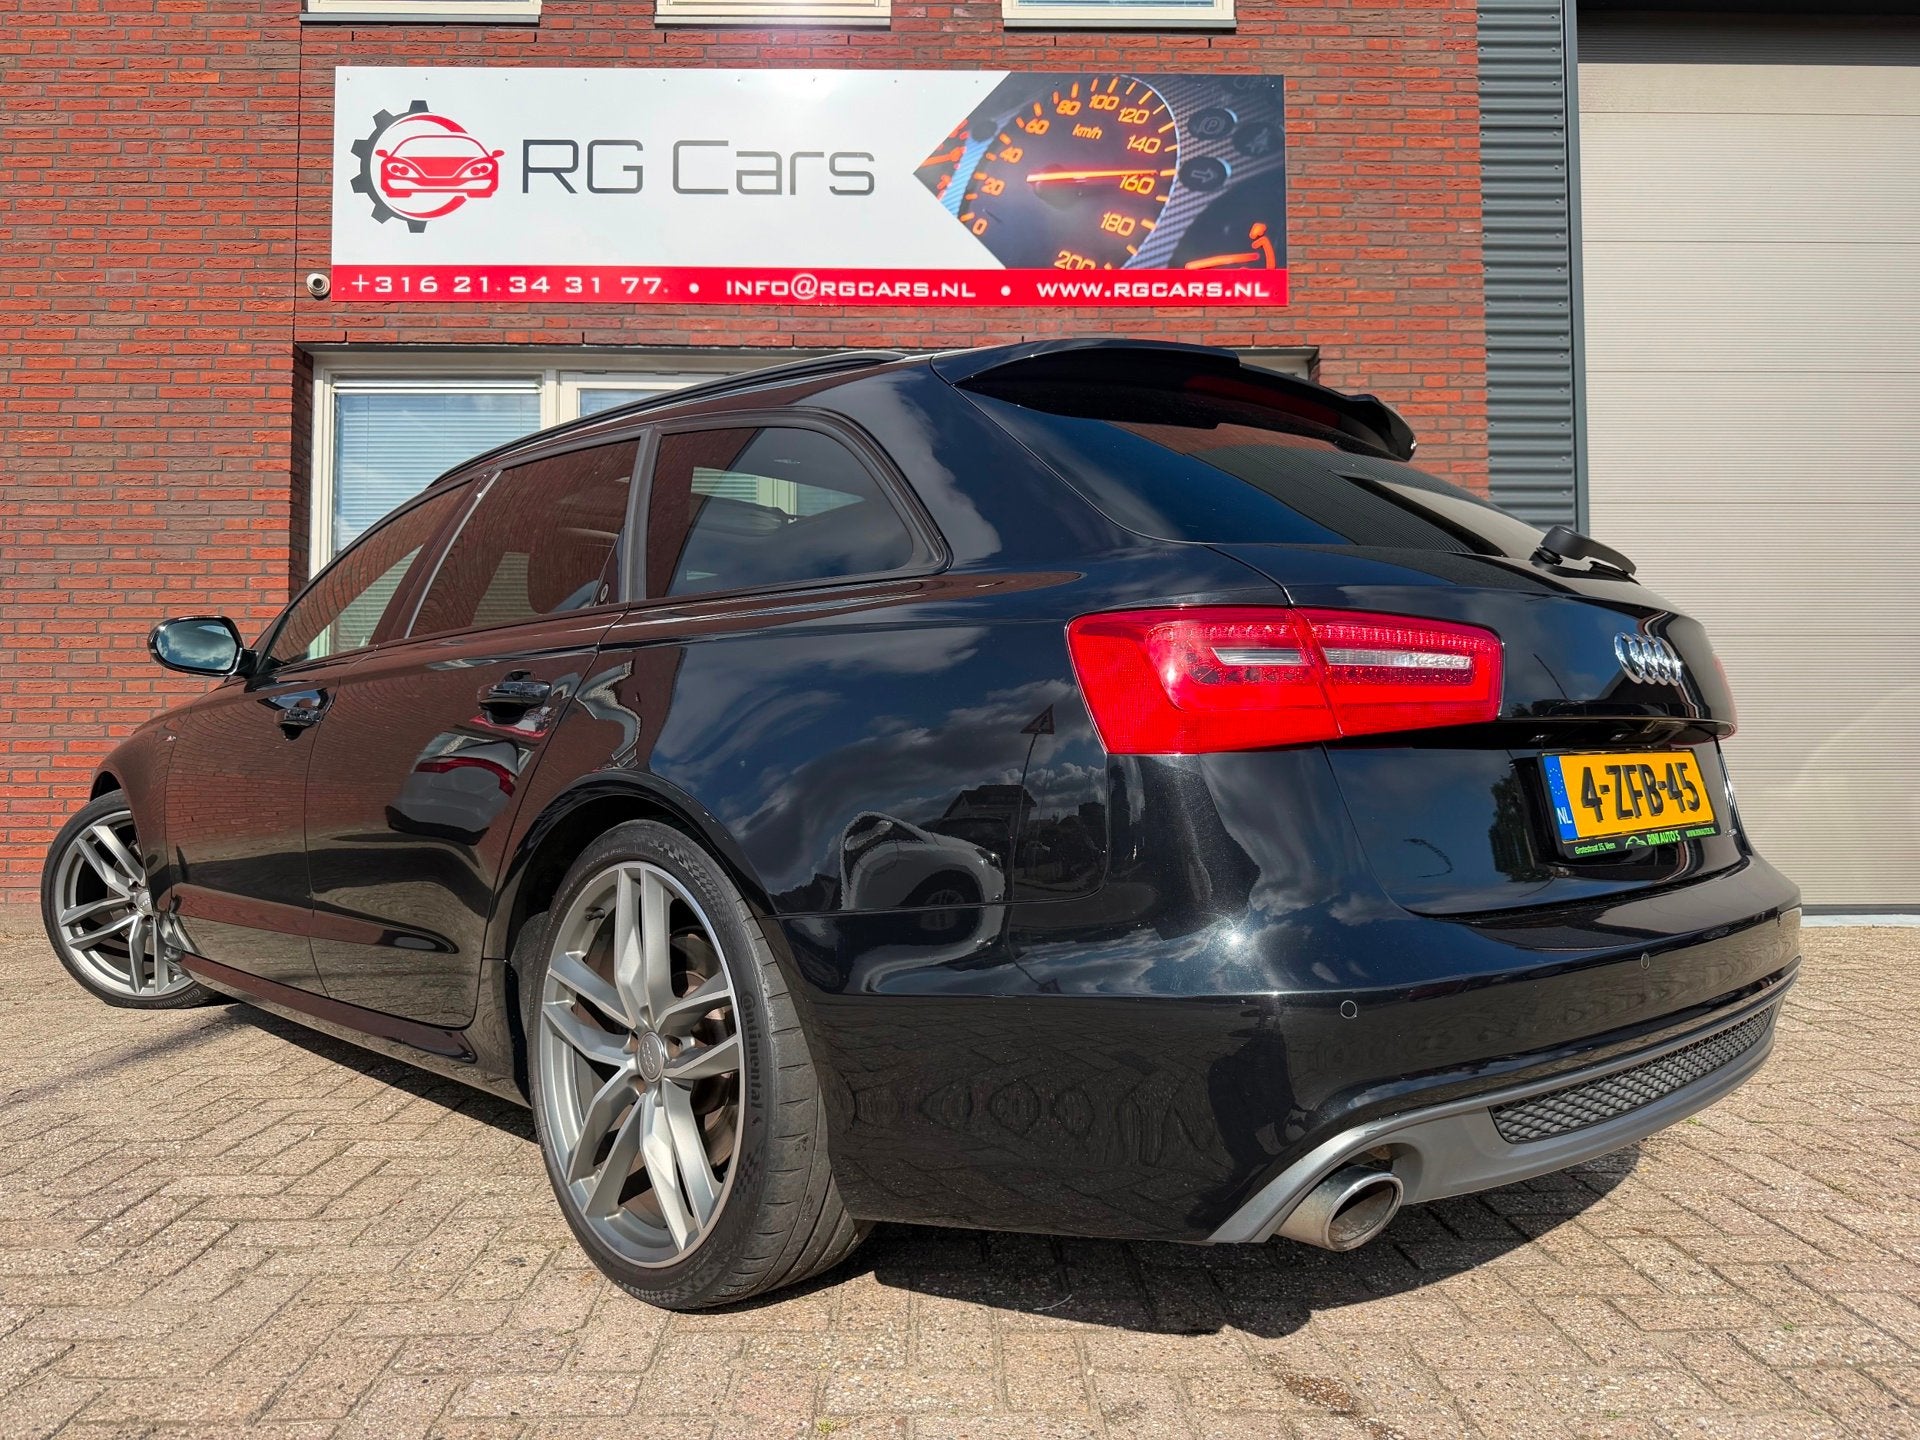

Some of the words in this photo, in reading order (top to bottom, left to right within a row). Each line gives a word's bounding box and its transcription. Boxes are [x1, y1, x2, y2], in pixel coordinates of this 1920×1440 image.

[1056, 99, 1082, 116] 80
[1089, 94, 1120, 111] 100
[1117, 107, 1150, 125] 120
[1024, 118, 1050, 135] 60
[1072, 122, 1103, 140] km/h
[1126, 134, 1161, 154] 140
[999, 146, 1024, 164] 40
[522, 138, 644, 195] RG
[672, 139, 876, 197] Cars
[981, 177, 1005, 196] 20
[1119, 173, 1156, 195] 160
[972, 217, 988, 236] 0
[1100, 210, 1136, 237] 180
[351, 273, 438, 294] +316
[453, 275, 489, 293] 21
[508, 275, 551, 293] 34
[564, 276, 601, 294] 31
[620, 276, 663, 295] 77
[725, 272, 976, 300] INFO@RGCARS.NL
[1035, 280, 1270, 299] WWW.RGCARS.NL
[1581, 762, 1701, 823] 4-ZFB-45
[1556, 806, 1573, 825] NL
[740, 990, 764, 1110] Continental
